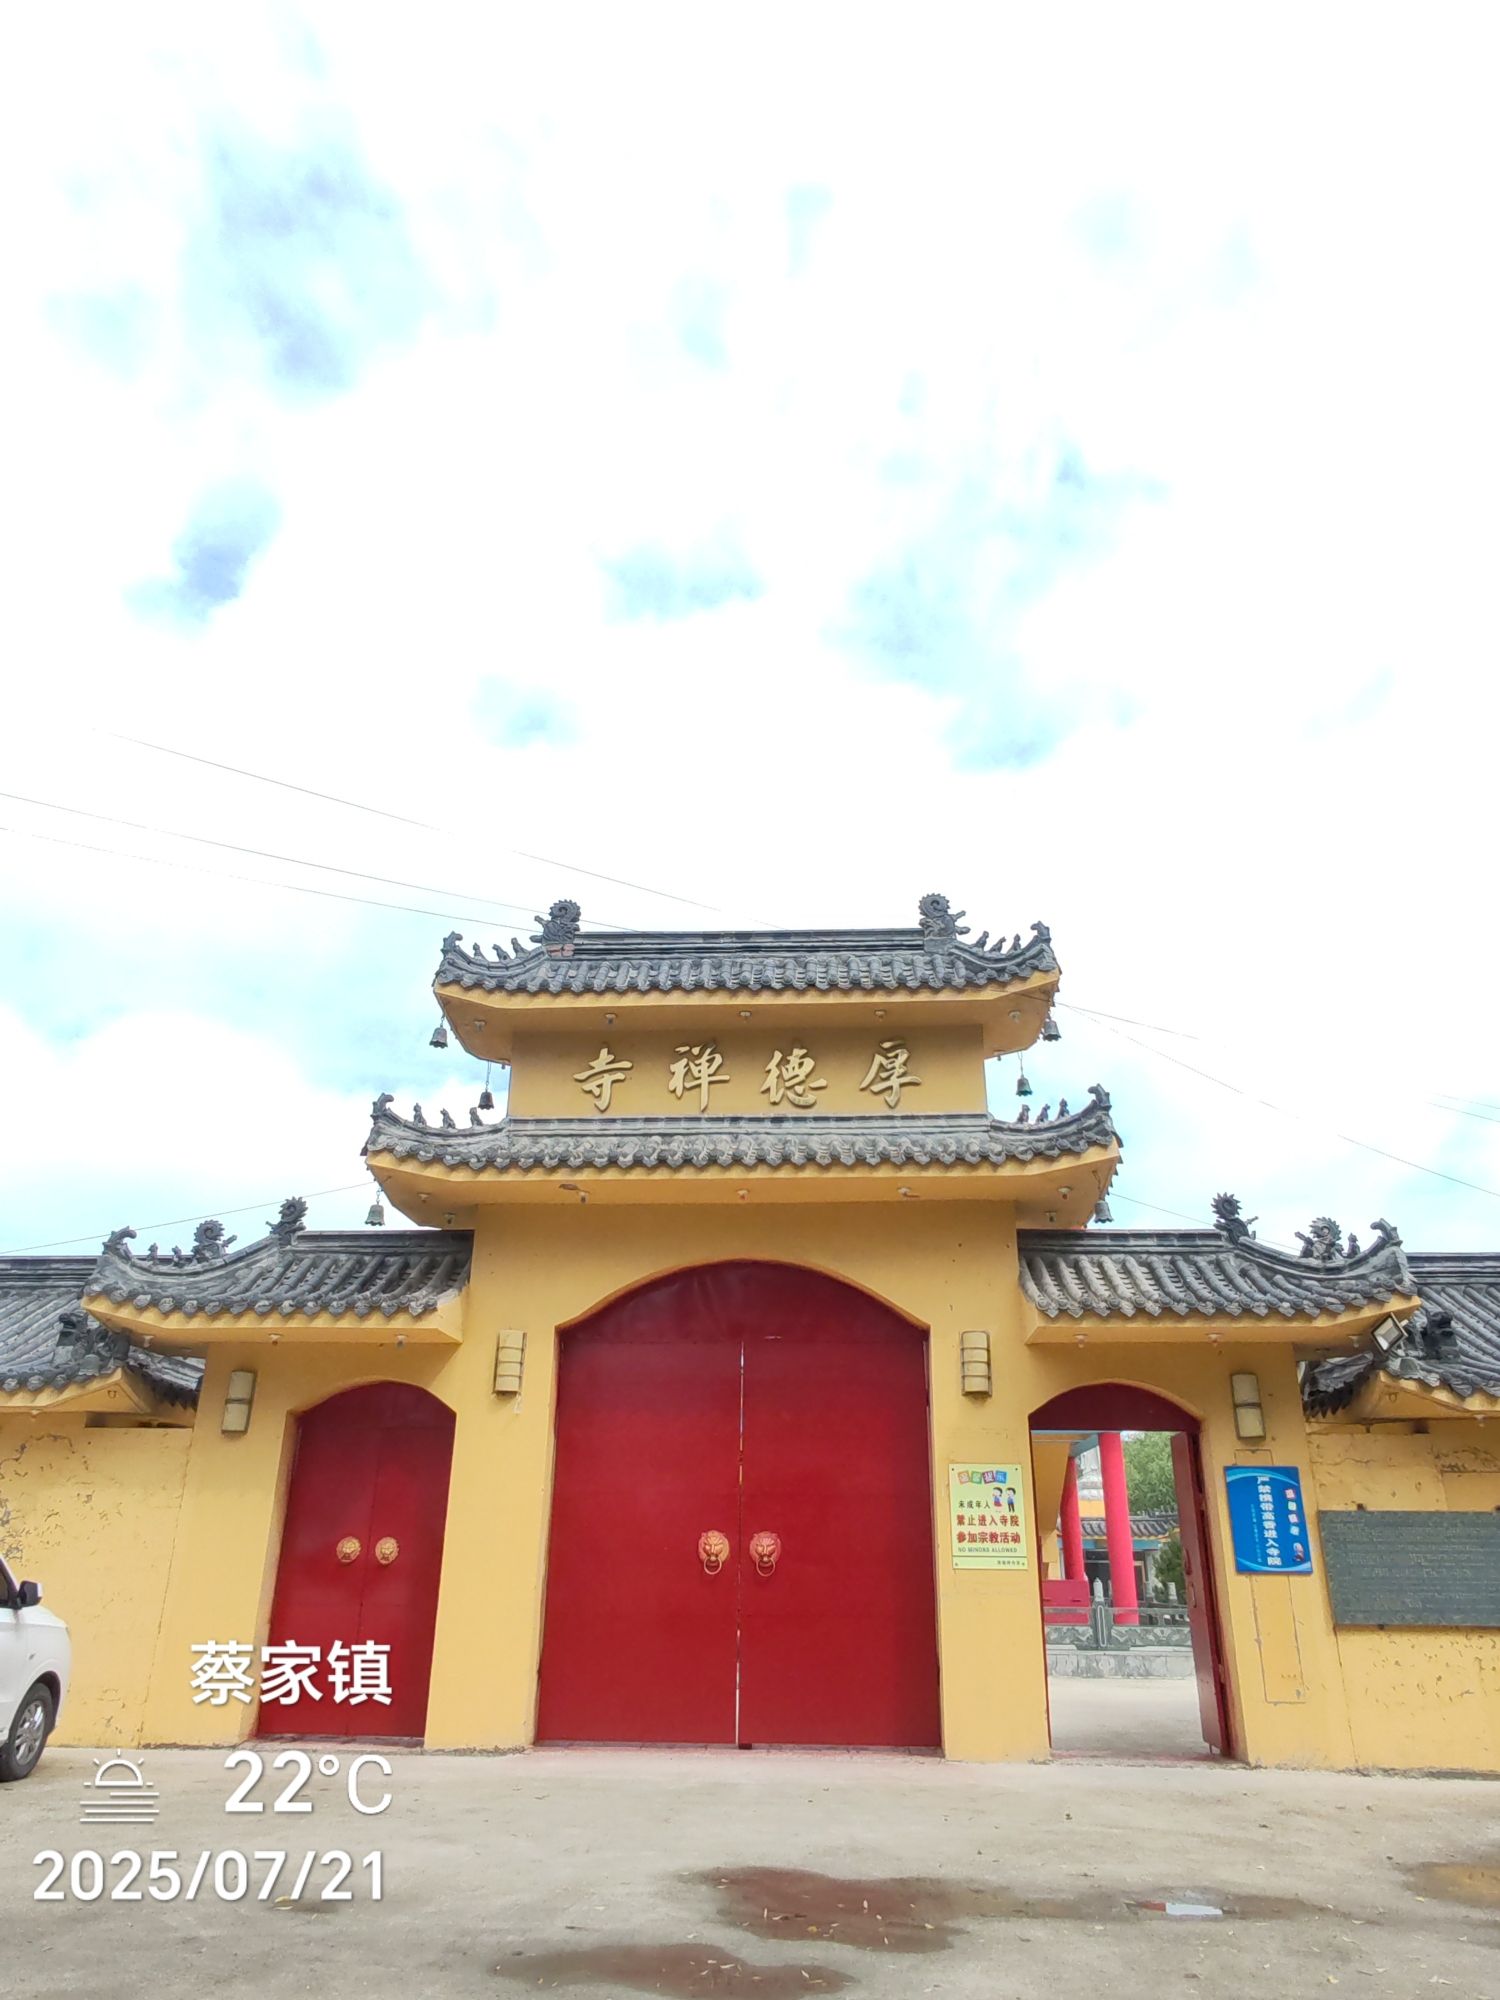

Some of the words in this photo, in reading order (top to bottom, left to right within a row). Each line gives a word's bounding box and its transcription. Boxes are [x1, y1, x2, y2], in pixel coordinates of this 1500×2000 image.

[958, 1500, 990, 1509] 未成年人
[956, 1514, 1020, 1527] 禁止进入寺院
[1257, 1476, 1282, 1566] 严禁携带高香进入寺院
[956, 1531, 1021, 1543] 参加宗教活动
